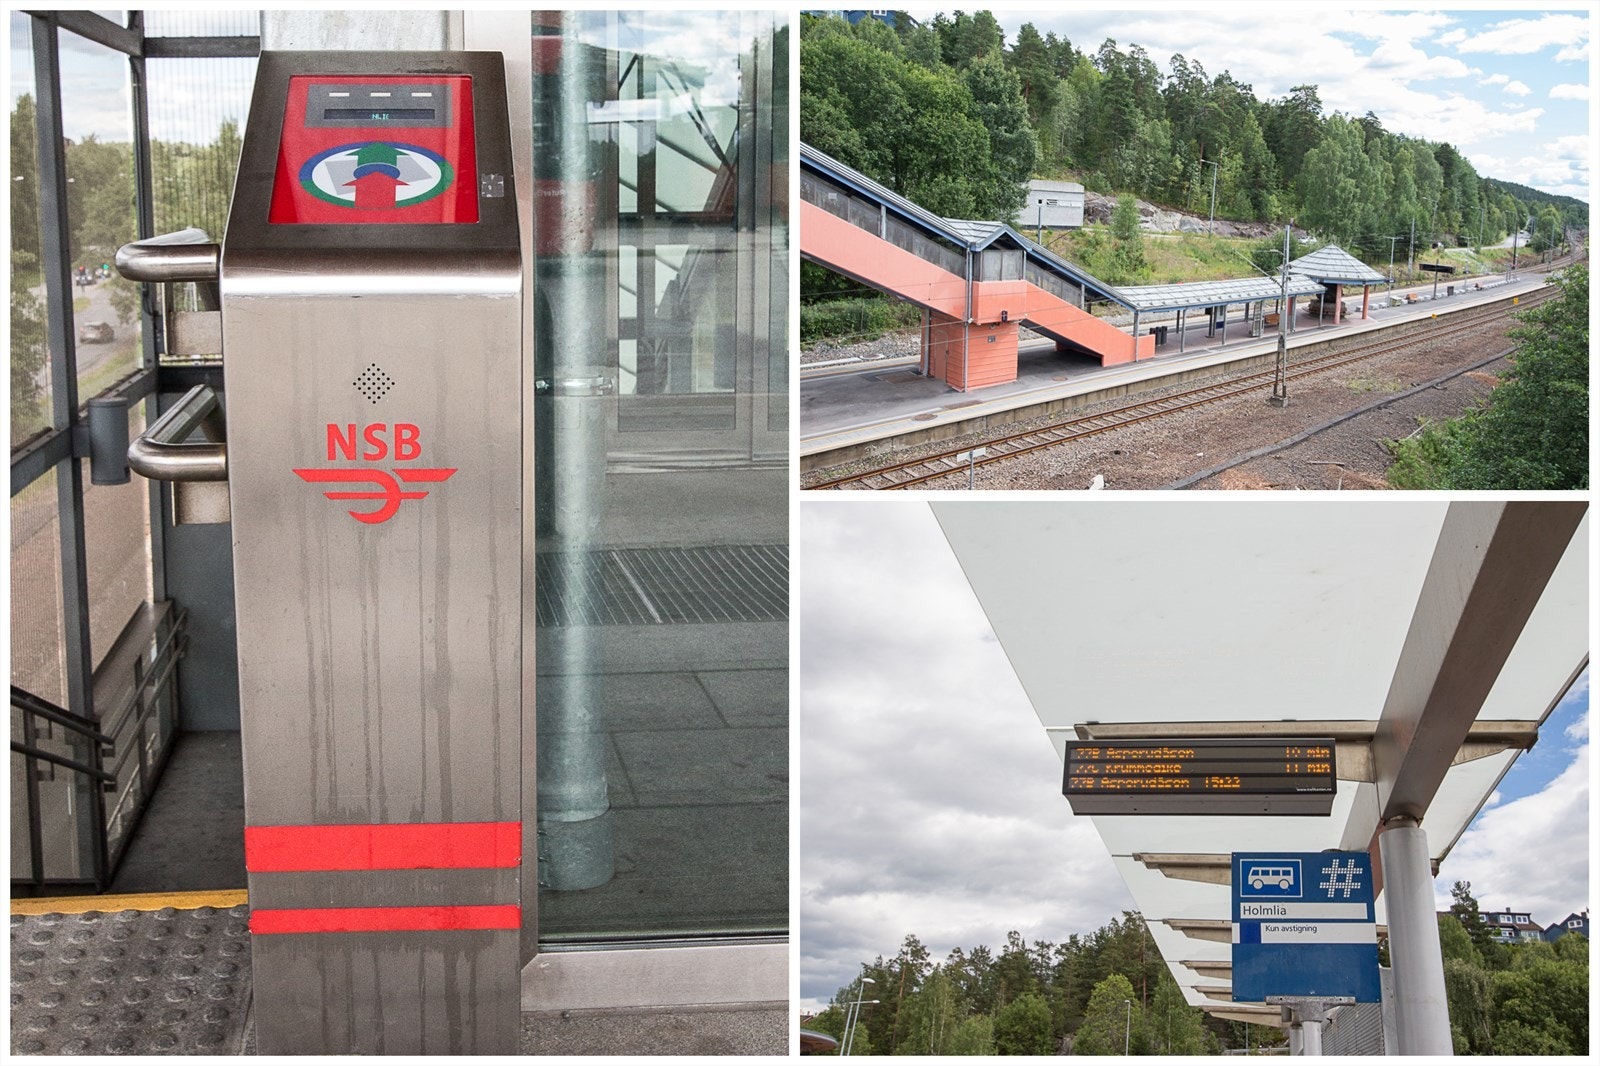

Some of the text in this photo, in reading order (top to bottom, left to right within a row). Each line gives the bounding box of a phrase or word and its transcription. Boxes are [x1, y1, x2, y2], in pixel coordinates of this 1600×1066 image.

[326, 423, 422, 461] NSB
[1307, 747, 1330, 758] min
[1307, 763, 1331, 773] min
[1242, 905, 1288, 916] Holmlia
[1265, 924, 1318, 934] Kun avstigning
